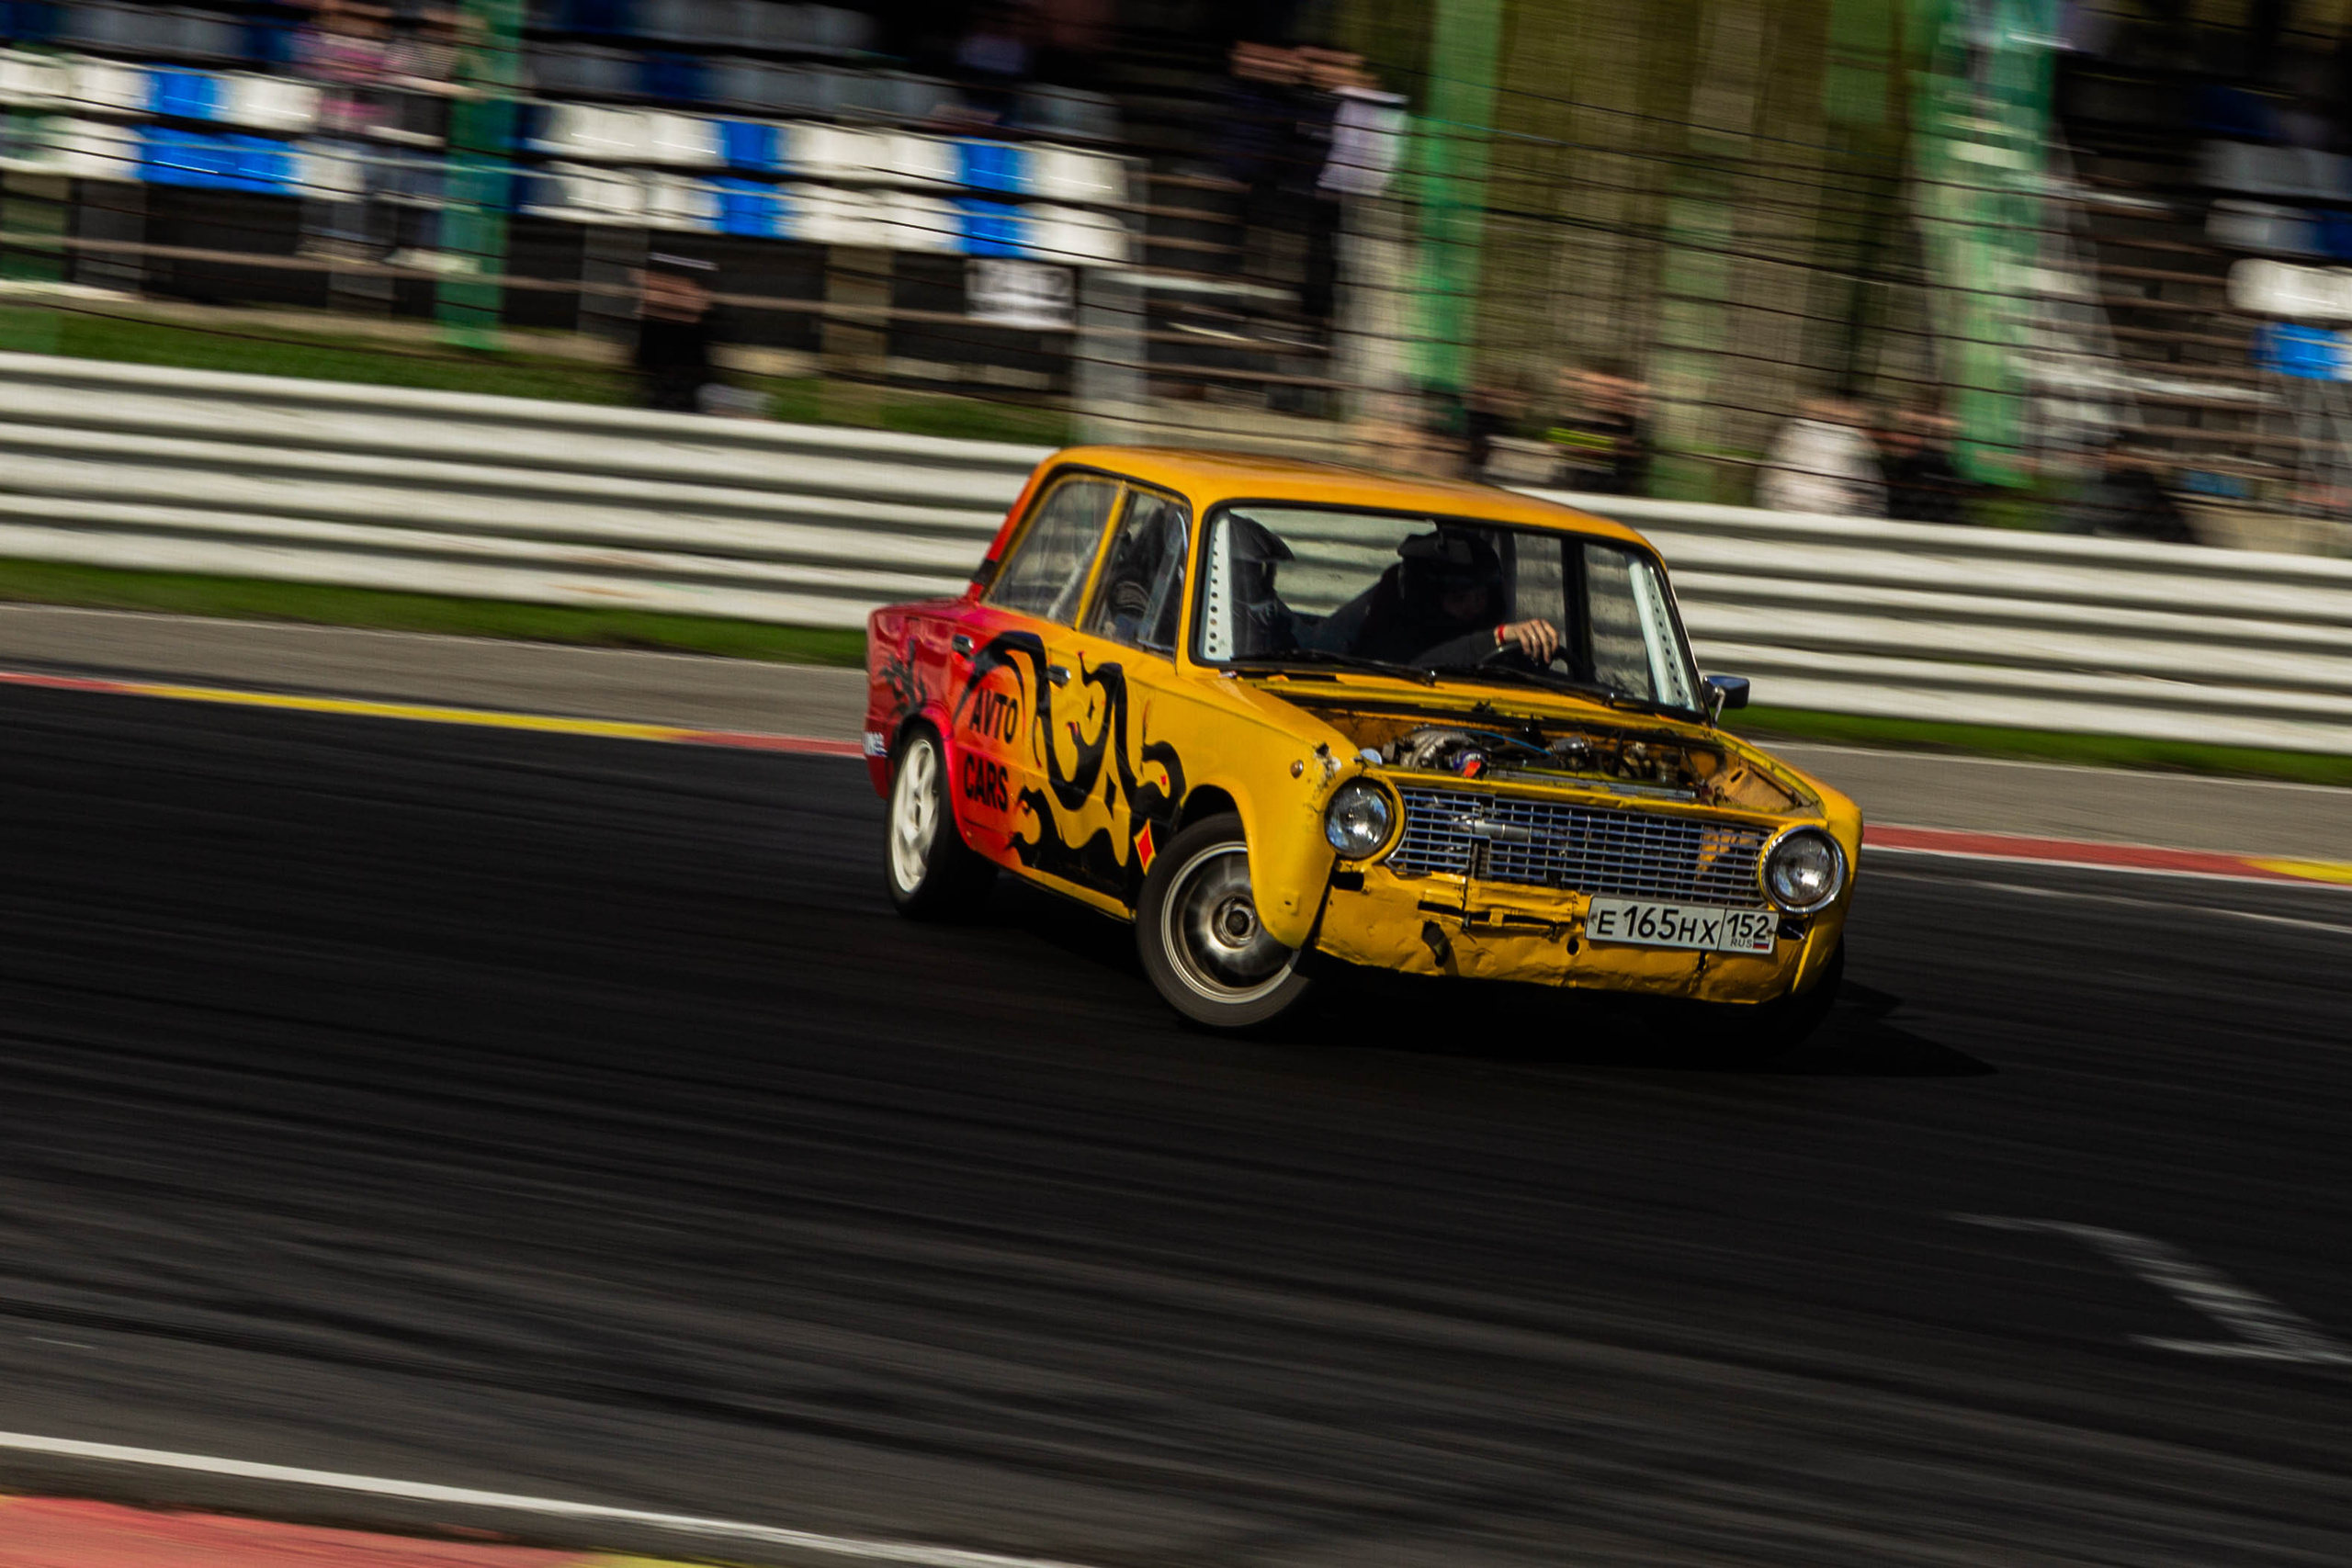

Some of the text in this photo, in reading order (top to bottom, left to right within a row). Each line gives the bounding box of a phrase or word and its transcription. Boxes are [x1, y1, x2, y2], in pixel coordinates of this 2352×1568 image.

[969, 688, 1018, 744] AVTO
[964, 754, 1009, 813] CARS
[1727, 913, 1770, 939] 152
[1730, 938, 1753, 948] RUS
